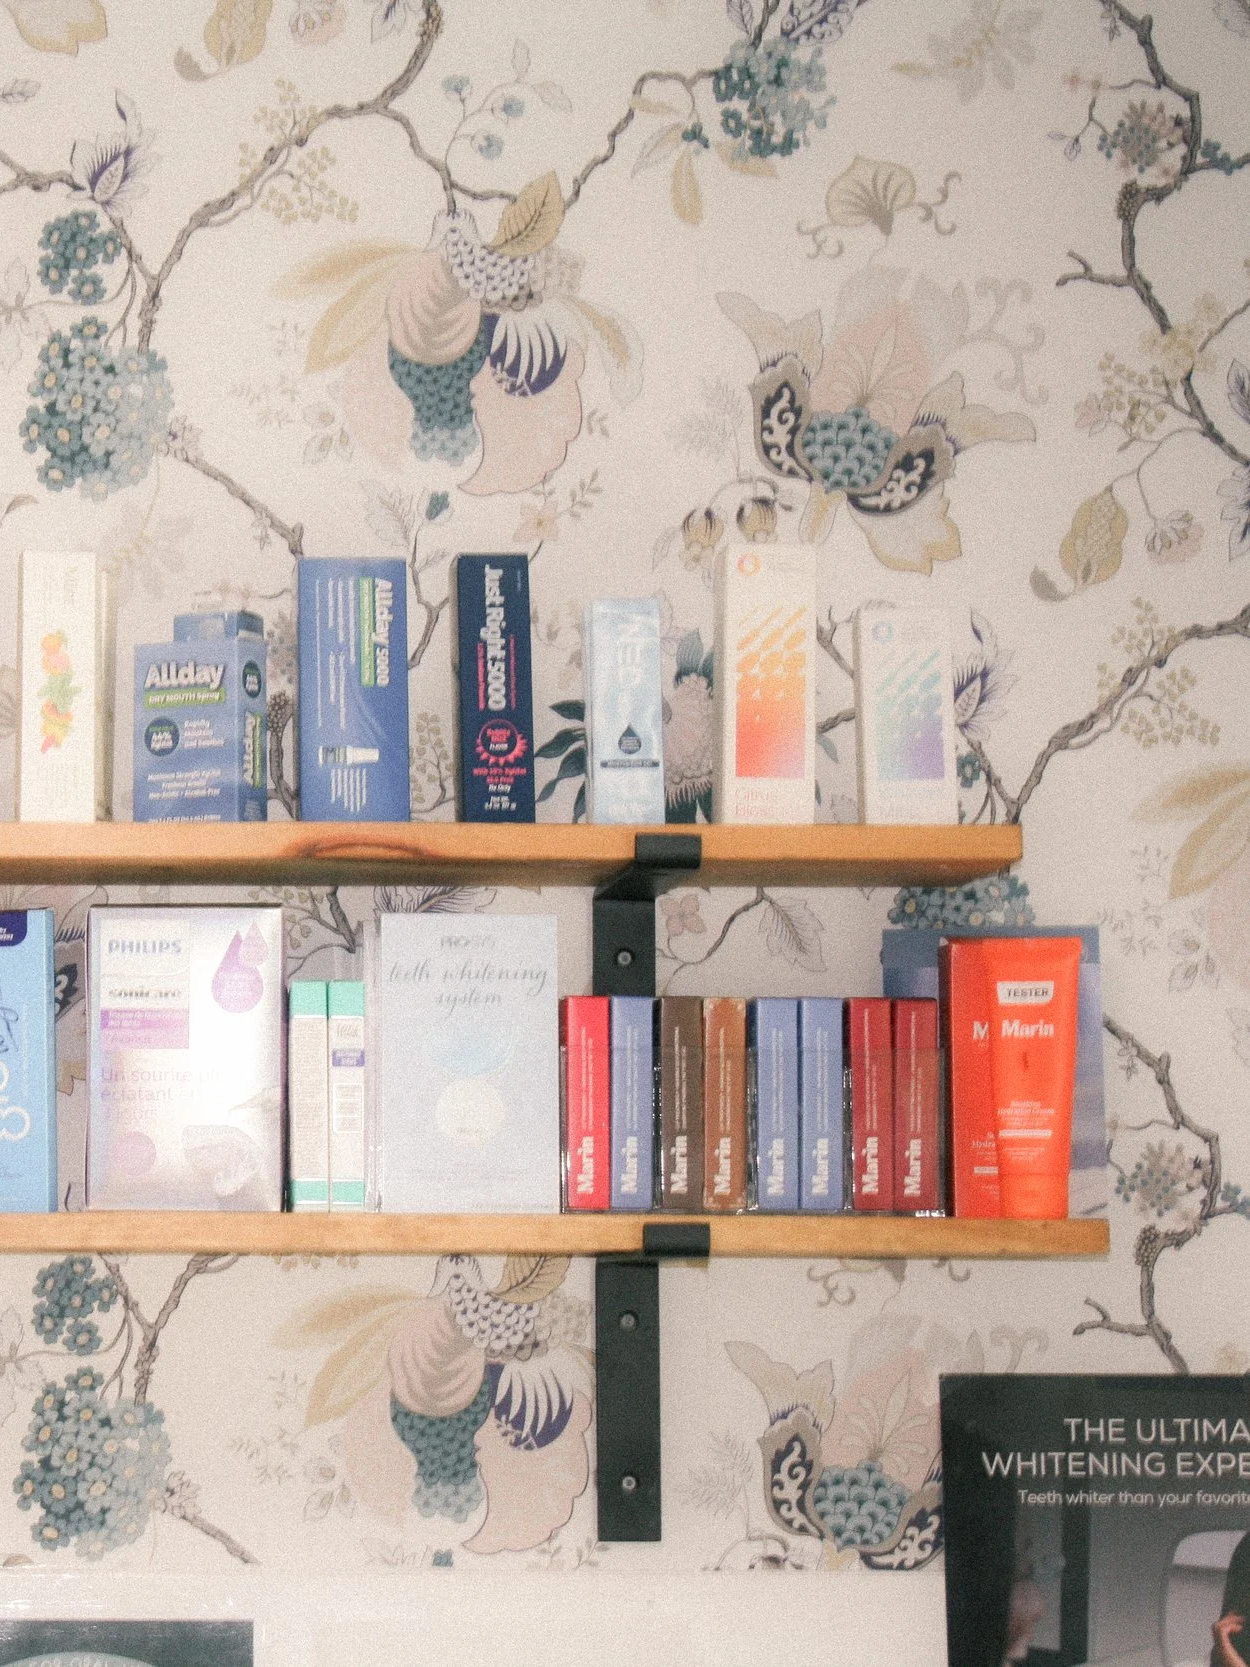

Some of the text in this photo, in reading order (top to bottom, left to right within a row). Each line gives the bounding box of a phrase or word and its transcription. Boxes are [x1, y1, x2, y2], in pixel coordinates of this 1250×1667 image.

[485, 564, 505, 606] Just
[370, 577, 394, 687] Allday 5000
[479, 606, 506, 660] Right
[144, 660, 226, 692] Allday
[486, 661, 507, 711] 5000
[108, 939, 182, 955] PHILIPS
[443, 958, 548, 997] whitening
[1007, 987, 1049, 998] TESTER
[435, 985, 502, 1020] system
[1001, 1018, 1055, 1039] Marin
[131, 1067, 191, 1083] sourire
[577, 1136, 594, 1195] Marin
[620, 1136, 638, 1195] Marin
[670, 1135, 688, 1195] Marin
[714, 1136, 732, 1195] Marin
[766, 1137, 784, 1196] Marin
[811, 1137, 829, 1196] Marin
[862, 1136, 879, 1195] Marin
[903, 1138, 922, 1198] Marin
[1063, 1417, 1250, 1443] THE ULTIMA
[981, 1451, 1250, 1478] WHITENING EXPE
[1018, 1489, 1063, 1504] Teeth
[1065, 1489, 1115, 1504] whiter
[1118, 1489, 1154, 1504] than
[1158, 1492, 1193, 1508] your
